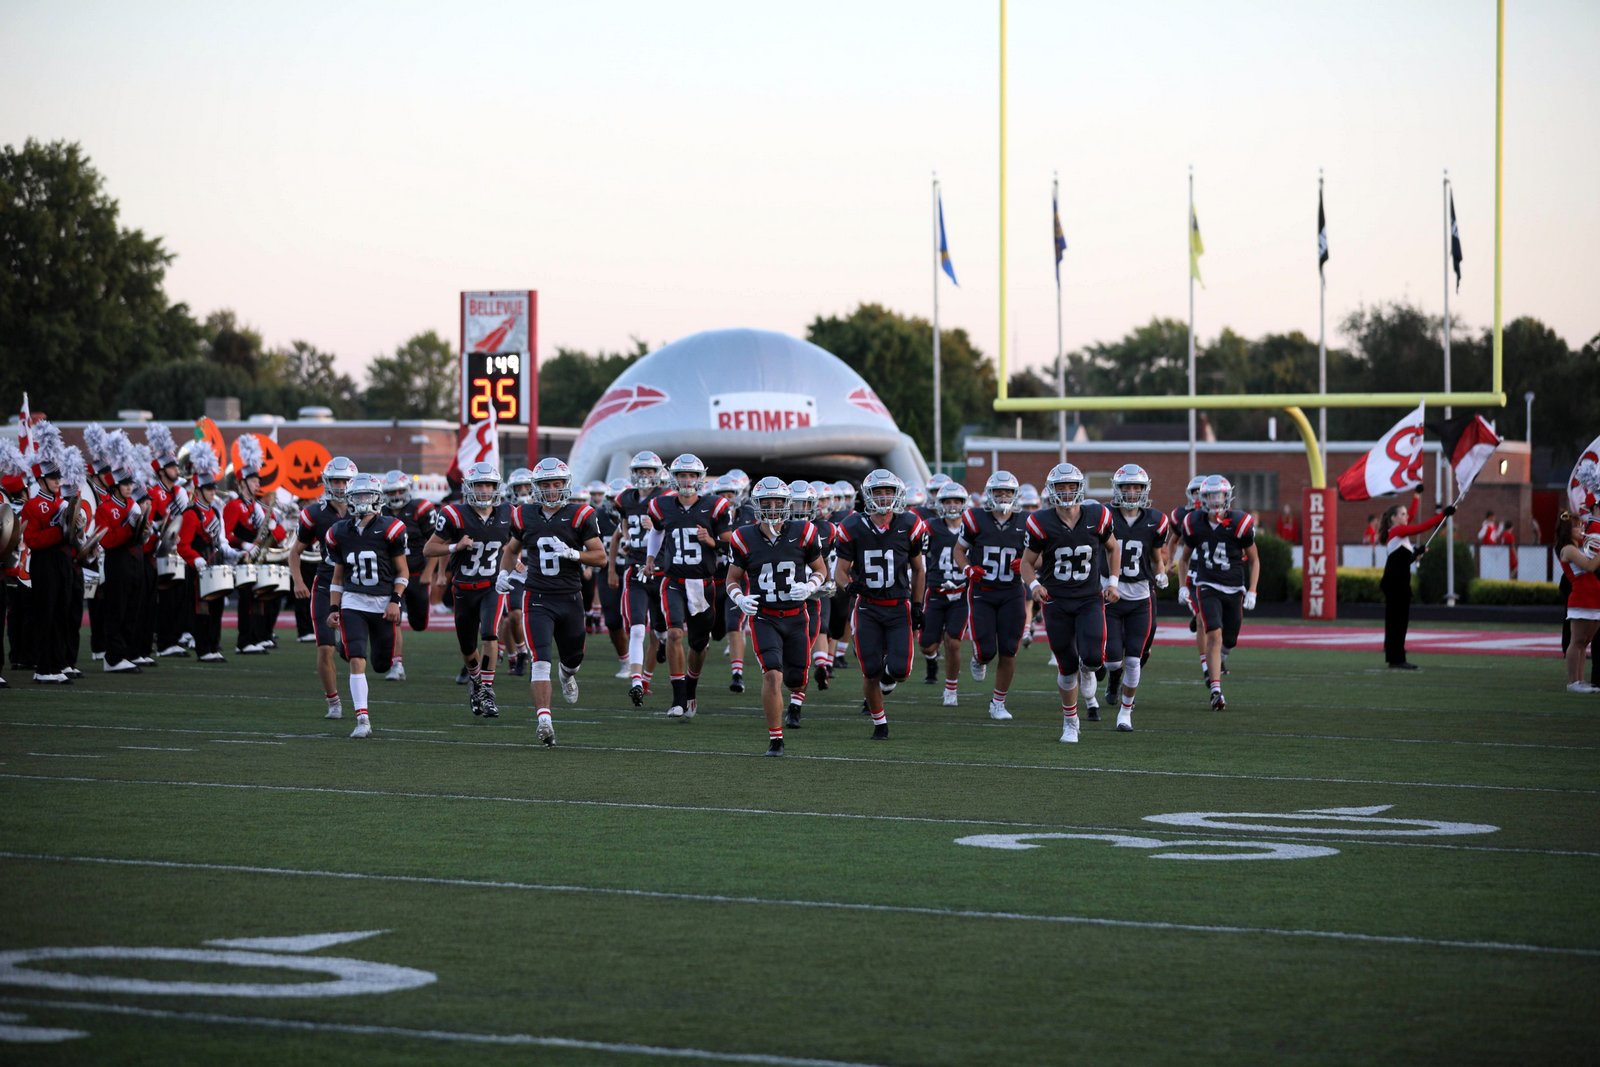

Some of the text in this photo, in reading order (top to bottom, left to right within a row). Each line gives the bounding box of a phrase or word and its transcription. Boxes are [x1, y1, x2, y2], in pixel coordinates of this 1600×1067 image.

[469, 298, 522, 316] BELLEVUE
[471, 378, 517, 419] 25
[38, 501, 50, 514] B
[461, 541, 502, 577] 33
[671, 527, 703, 565] 15
[982, 545, 1017, 582] 50
[1053, 544, 1093, 581] 63
[1201, 541, 1231, 570] 14
[1308, 492, 1326, 616] REDMEN
[346, 550, 379, 587] 10
[757, 560, 797, 602] 43
[863, 549, 896, 589] 51
